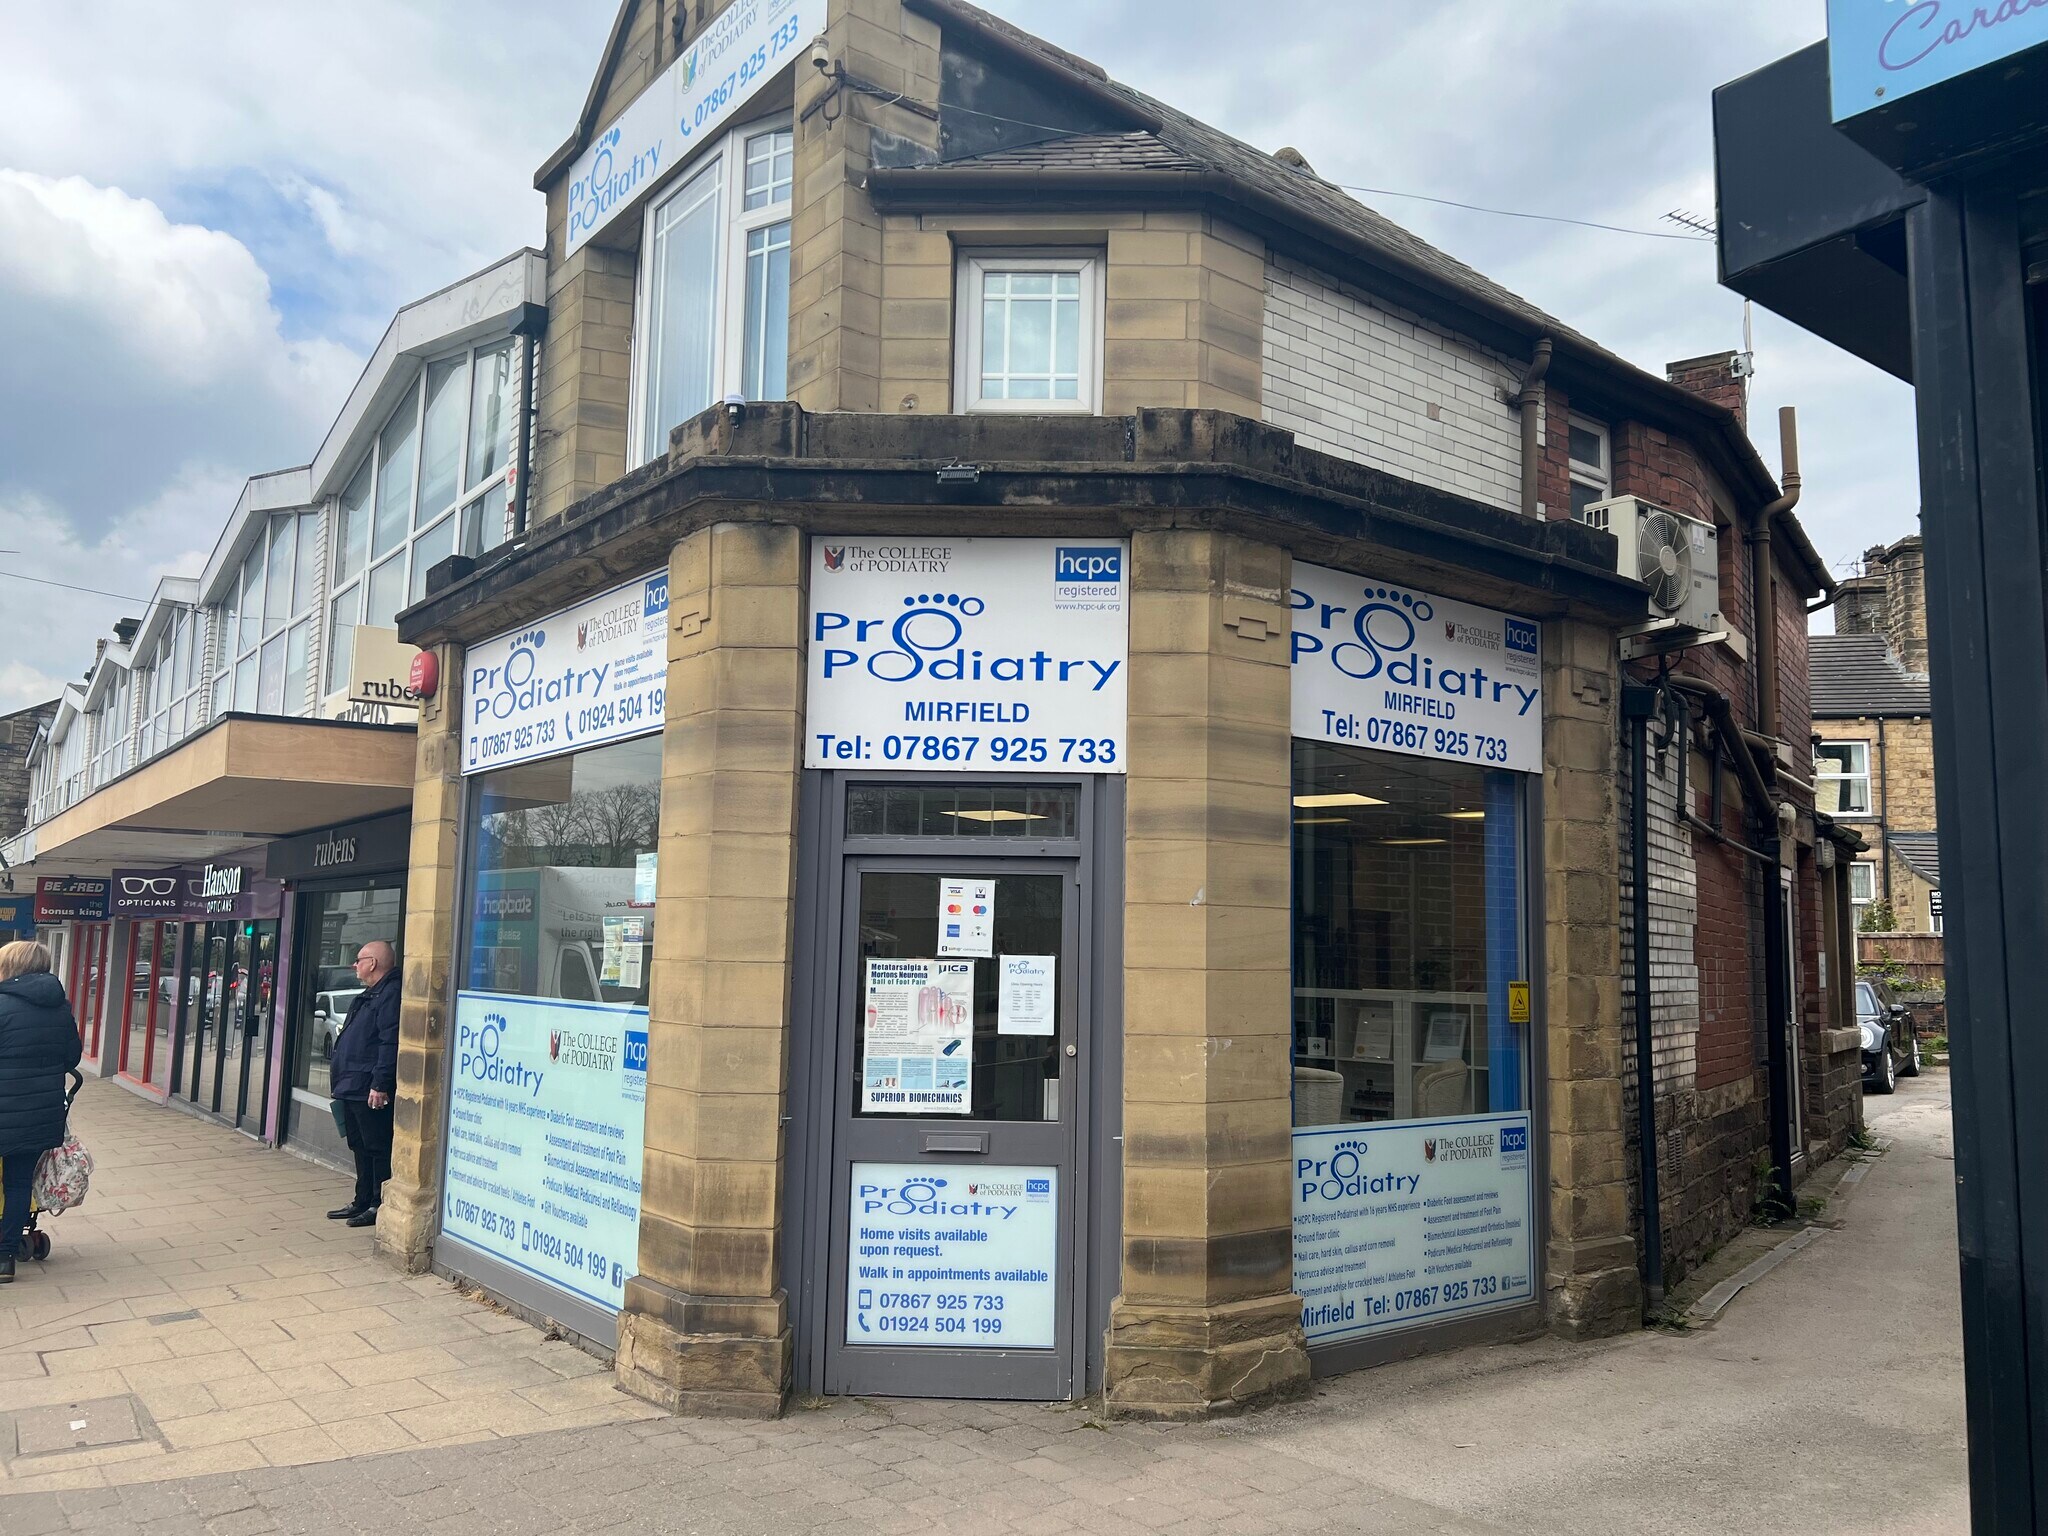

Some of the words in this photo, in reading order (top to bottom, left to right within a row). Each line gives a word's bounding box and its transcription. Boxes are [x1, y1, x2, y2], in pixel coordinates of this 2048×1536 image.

[700, 33, 715, 53] The
[708, 4, 758, 66] PODIATRY
[694, 73, 736, 128] 07867
[740, 44, 766, 88] 925
[770, 14, 798, 59] 733
[849, 546, 875, 559] The
[878, 547, 952, 559] COLLEGE
[850, 560, 865, 573] of
[867, 560, 950, 573] PODIATRY
[1059, 551, 1117, 579] hcpc
[646, 585, 668, 610] hcp
[1059, 585, 1117, 600] registered
[589, 618, 601, 632] The
[603, 600, 641, 626] COLLEGE
[644, 616, 668, 632] registere
[589, 632, 597, 648] of
[597, 617, 639, 645] PODIATRY
[1456, 624, 1468, 634] The
[1469, 627, 1501, 642] COLLEGE
[1506, 621, 1536, 649] hcpc
[1457, 635, 1464, 643] of
[1465, 636, 1500, 651] PODIATRY
[1506, 652, 1536, 665] registered
[905, 701, 1030, 723] MIRFIELD
[1385, 691, 1455, 720] MIRFIELD
[482, 730, 511, 759] 07867
[514, 722, 532, 751] 925
[536, 718, 555, 745] 733
[579, 702, 614, 734] 01924
[619, 694, 642, 724] 504
[648, 688, 666, 716] 19
[1322, 709, 1360, 740] Tel:
[1367, 717, 1428, 749] 07867
[1434, 729, 1468, 757] 925
[1474, 735, 1507, 762] 733
[816, 734, 871, 760] Tel:
[883, 735, 980, 762] 07867
[990, 737, 1047, 763] 925
[1059, 738, 1116, 764] 733
[314, 830, 356, 867] rubens
[43, 881, 104, 893] BEFRED
[202, 864, 241, 898] Hanson
[41, 907, 74, 915] bonus
[79, 908, 102, 917] king
[206, 899, 233, 914] OPTICIANS
[561, 928, 576, 937] the
[871, 963, 923, 972] Metatarsalgia
[871, 971, 898, 979] Mortons
[898, 971, 928, 979] Neuroma
[562, 1031, 576, 1047] The
[577, 1032, 618, 1054] COLLEGE
[626, 1035, 646, 1067] hcp
[562, 1051, 570, 1065] of
[570, 1050, 616, 1072] PODIATRY
[871, 1092, 906, 1103] SUPERIOR
[909, 1093, 963, 1103] BIOMECHANICS
[1439, 1139, 1454, 1150] The
[1455, 1134, 1495, 1148] COLLEGE
[1501, 1130, 1525, 1149] hcpc
[1440, 1151, 1448, 1162] of
[1450, 1147, 1493, 1161] PODIATRY
[980, 1183, 990, 1191] The
[991, 1183, 1023, 1191] COLLEGE
[987, 1189, 1023, 1197] PODIATRY
[1027, 1180, 1048, 1192] hcpc
[1298, 1214, 1312, 1225] HCPC
[1312, 1211, 1337, 1224] Registered
[1337, 1208, 1359, 1220] Podiatrist
[1359, 1206, 1369, 1216] with
[1375, 1205, 1387, 1217] years
[1388, 1203, 1398, 1213] NHS
[1398, 1201, 1421, 1213] experience
[456, 1199, 479, 1228] 07867
[481, 1208, 497, 1232] 925
[499, 1216, 515, 1241] 733
[533, 1229, 561, 1261] 01924
[564, 1242, 583, 1270] 504
[587, 1251, 606, 1280] 199
[860, 1227, 894, 1240] Home
[899, 1228, 931, 1241] visits
[934, 1229, 988, 1242] available
[1298, 1231, 1316, 1244] Ground
[1316, 1230, 1327, 1241] floor
[1328, 1228, 1340, 1239] clinic
[860, 1245, 889, 1258] upon
[894, 1244, 943, 1259] request.
[1298, 1252, 1308, 1263] Nail
[1321, 1248, 1332, 1259] hard
[1344, 1243, 1359, 1255] callus
[1359, 1242, 1367, 1252] and
[1367, 1241, 1378, 1251] corn
[1378, 1237, 1396, 1249] removal
[859, 1266, 888, 1279] Walk
[892, 1267, 904, 1279] in
[907, 1267, 990, 1282] appointments
[994, 1269, 1048, 1282] available
[1320, 1265, 1335, 1277] advise
[1335, 1264, 1344, 1274] and
[1344, 1260, 1367, 1272] treatment
[880, 1293, 931, 1309] 07867
[936, 1294, 968, 1310] 925
[974, 1295, 1004, 1311] 733
[1300, 1300, 1354, 1328] Mirfield
[1363, 1296, 1390, 1316] Tel:
[1395, 1286, 1439, 1312] 07867
[1443, 1281, 1468, 1303] 925
[1472, 1275, 1497, 1298] 733
[879, 1315, 930, 1332] 01924
[934, 1317, 966, 1332] 504
[972, 1318, 1002, 1334] 199
